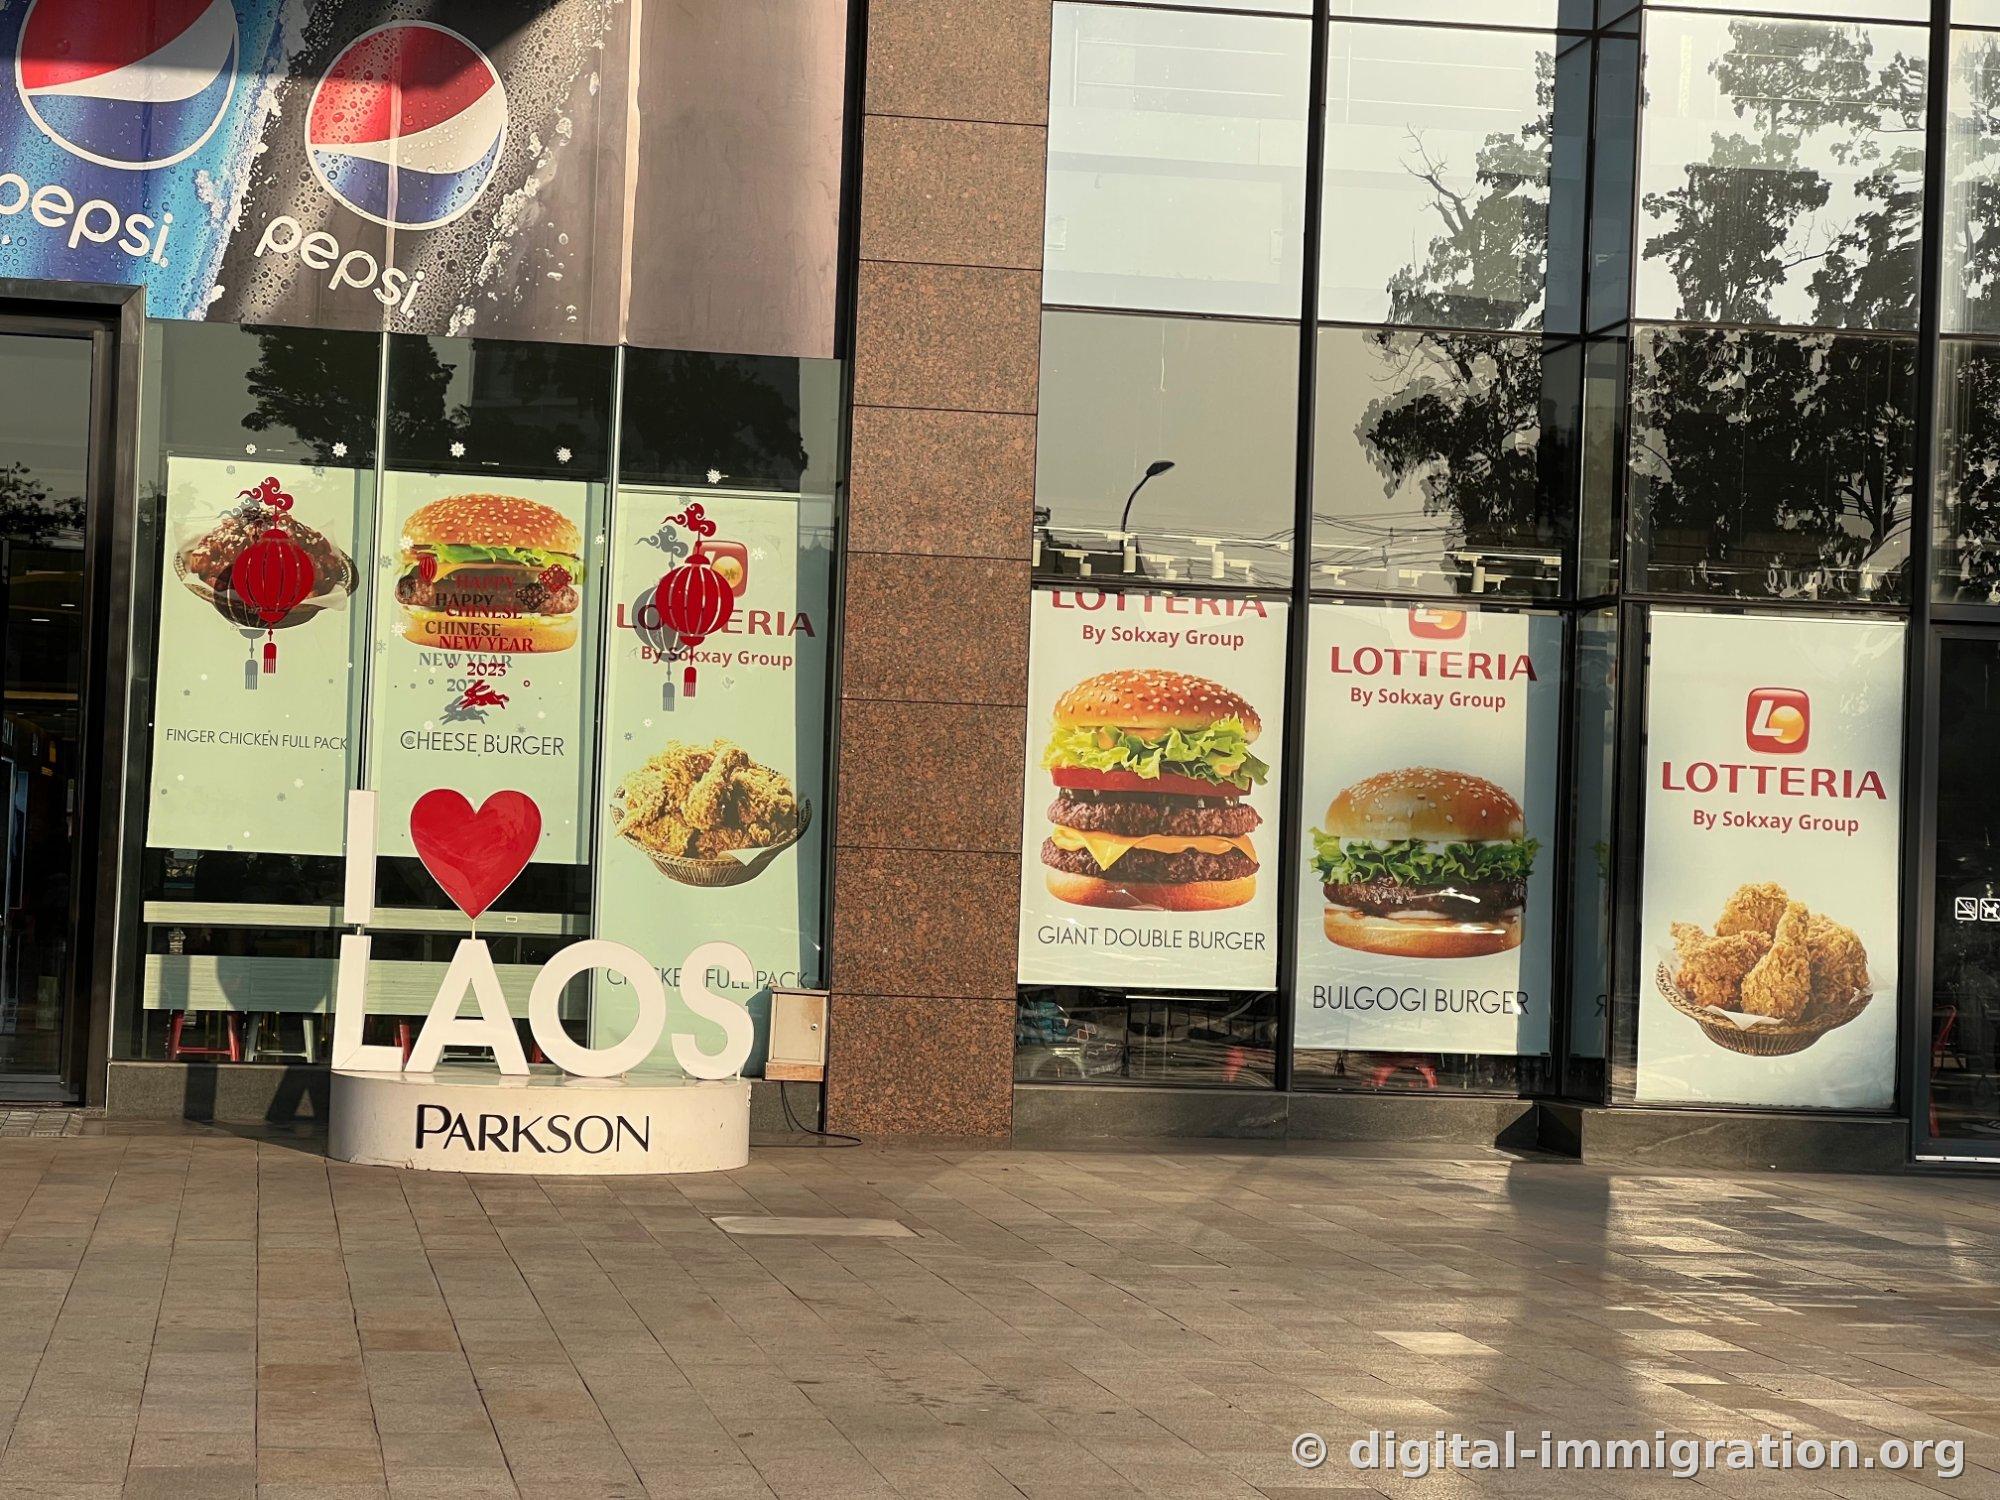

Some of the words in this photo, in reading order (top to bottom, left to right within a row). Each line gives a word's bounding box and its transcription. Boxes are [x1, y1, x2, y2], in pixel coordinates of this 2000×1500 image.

[254, 215, 425, 314] pepsi
[616, 603, 816, 638] LOERIA
[440, 635, 481, 650] NEW
[486, 637, 534, 652] YEAR
[1082, 624, 1106, 644] By
[1111, 625, 1180, 648] Sokxay
[1186, 629, 1244, 651] Group
[466, 662, 507, 676] 2023
[641, 645, 662, 664] By
[669, 646, 733, 667] Sokxay
[738, 650, 793, 670] Group
[1331, 646, 1538, 681] LOTTERIA
[1350, 687, 1373, 707] By
[1378, 688, 1444, 710] Sokxay
[1449, 691, 1506, 710] Group
[166, 728, 215, 744] FINGER
[218, 731, 278, 746] CHICKEN
[282, 734, 310, 748] FULL
[313, 736, 348, 750] PACK
[400, 731, 477, 752] CHEESE
[484, 734, 565, 756] BURGER
[1662, 761, 1887, 800] LOTTERIA
[1693, 808, 1717, 829] By
[1722, 809, 1793, 833] Sokxay
[1798, 813, 1859, 836] Group
[344, 790, 378, 924] I
[1038, 925, 1099, 945] GIANT
[1104, 927, 1182, 948] DOUBLE
[1189, 930, 1266, 950] BURGER
[331, 934, 754, 1080] LAOS
[1312, 985, 1427, 1012] BULGOGI
[1435, 989, 1529, 1015] BURGER
[415, 1104, 650, 1154] PARKSON
